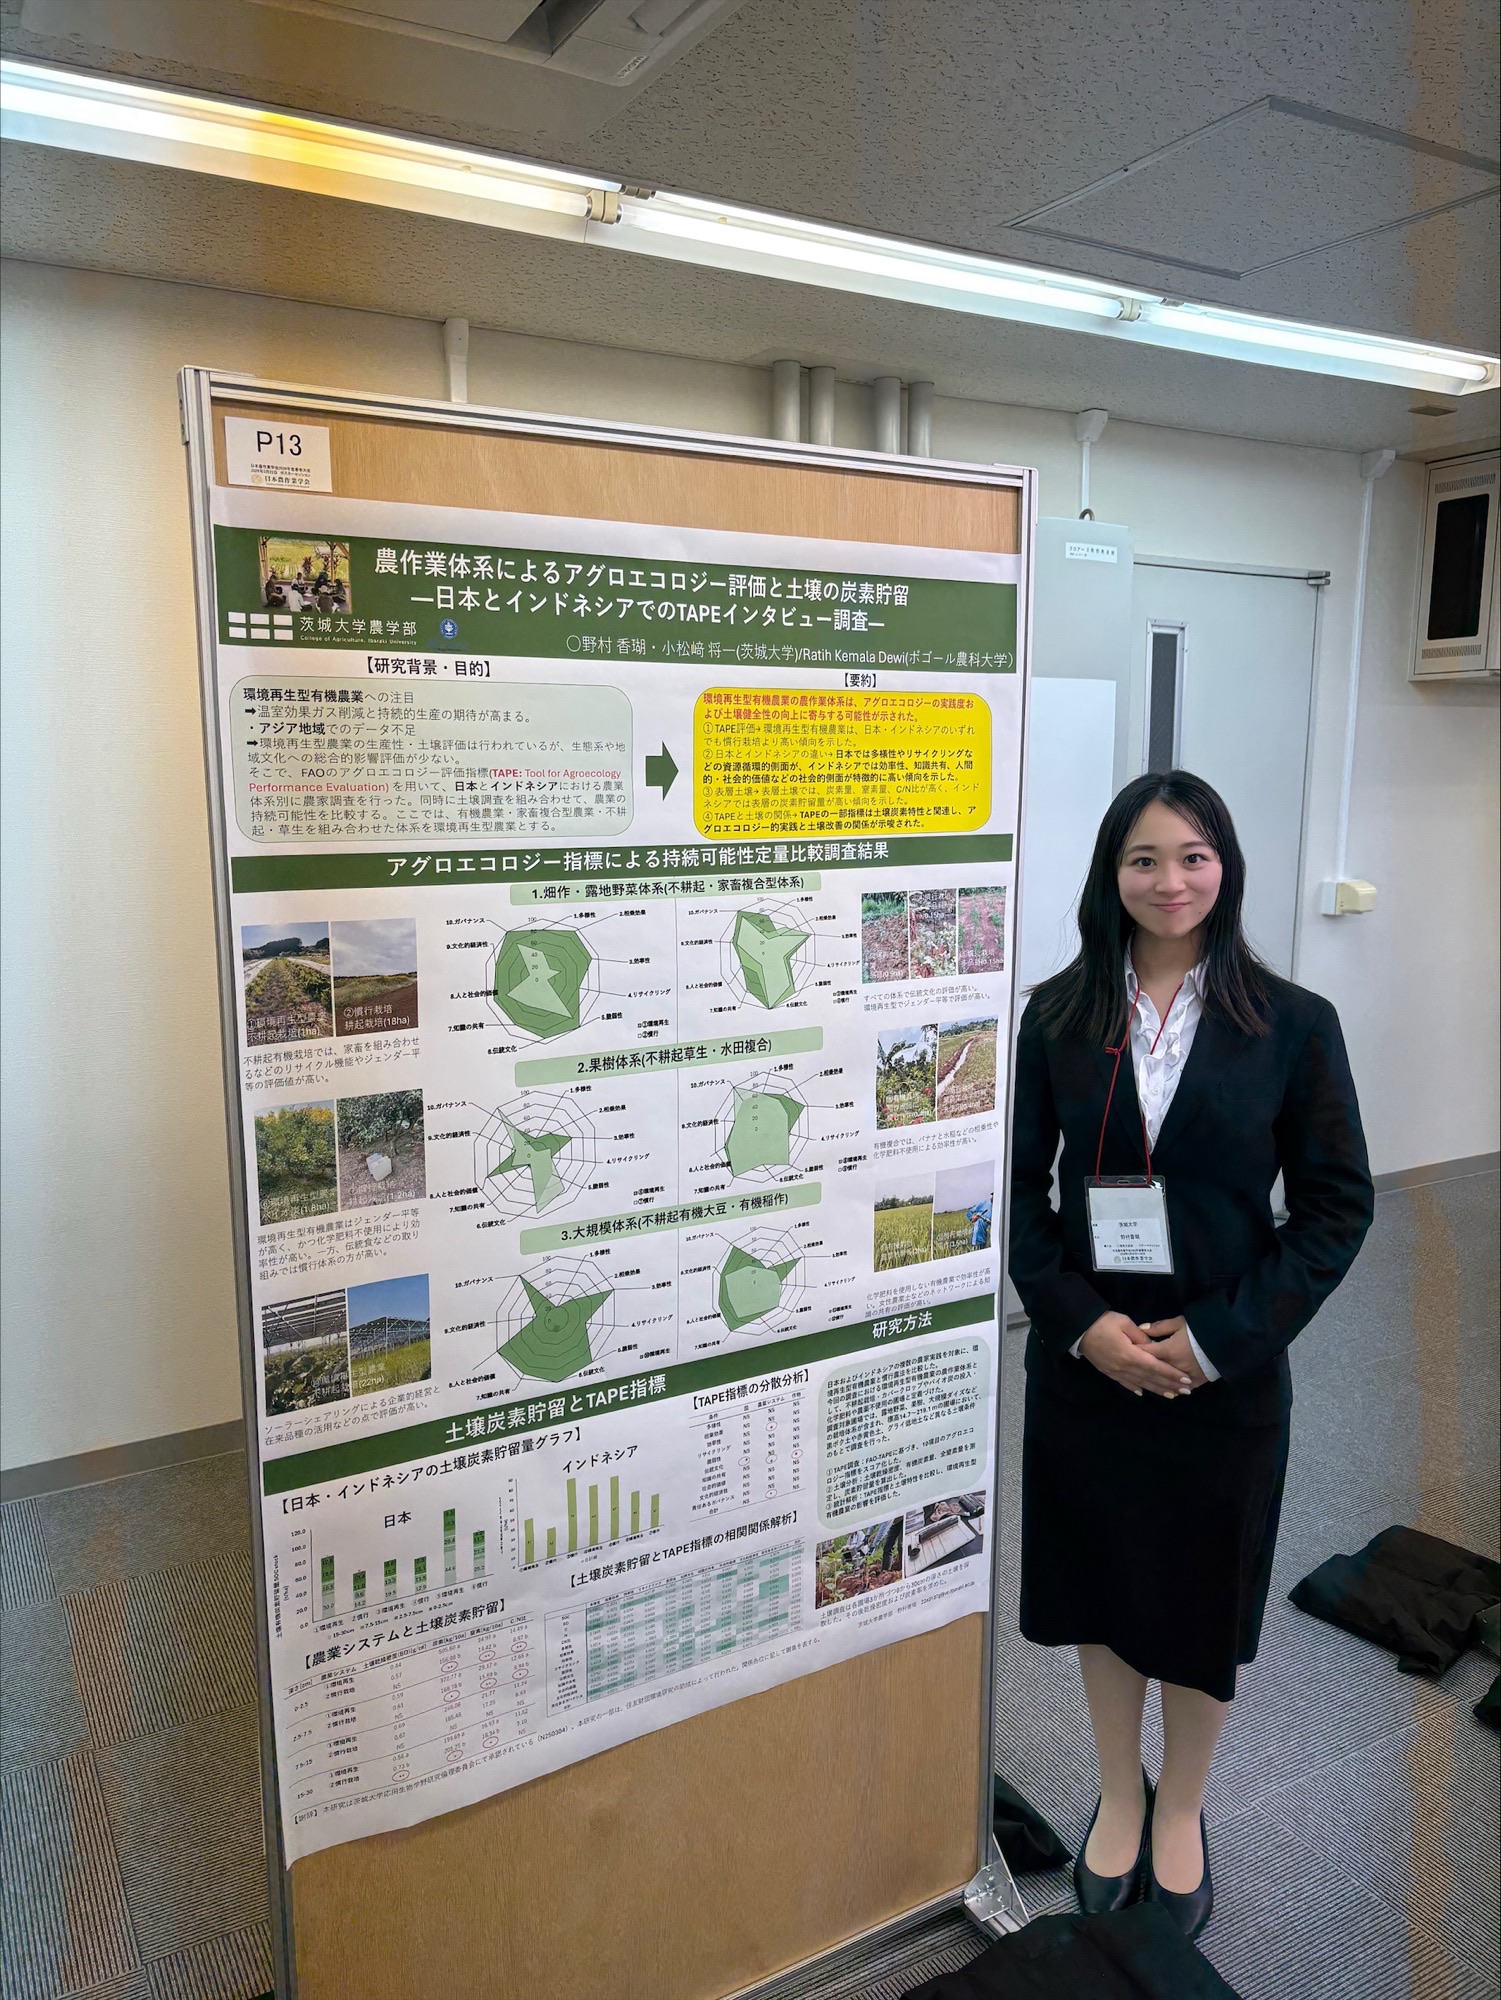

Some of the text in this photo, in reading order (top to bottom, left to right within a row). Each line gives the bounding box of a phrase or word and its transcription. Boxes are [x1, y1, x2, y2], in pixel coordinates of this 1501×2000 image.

[256, 431, 302, 456] P13
[374, 547, 909, 607] 農作業体系によるアグロエコロジー評価と土壌の炭素貯留
[300, 617, 417, 636] 茨城大学農学部
[367, 656, 491, 677] 【研究背景・目的】
[835, 650, 876, 663] Kemala
[844, 673, 877, 688] 【要約】
[243, 688, 414, 704] 環境再生型有機農業への注目
[249, 782, 323, 793] Performance
[326, 782, 389, 794] Evaluation)
[525, 769, 545, 778] Tool
[547, 769, 561, 778] for
[563, 769, 622, 780] Agroecology
[386, 841, 889, 877] アグロエコロジー指標による持続可能性定量比較調査結果
[577, 1038, 772, 1074] 2.果樹体系(不耕起草生・水田複合)
[245, 1073, 330, 1091] 等の評価値が高い。
[257, 1208, 420, 1245] 環境再生型有機農業はジェンダー平等
[561, 1192, 789, 1242] 3.大規模体系(不耕起有機大豆・有機稲作)
[872, 1311, 932, 1339] 研究方法
[693, 1368, 809, 1410] 【TAPE指標の分散分析】
[445, 1373, 667, 1444] 土壌炭素貯留とTAPE指標
[282, 1426, 581, 1515] 【日本・インドネシアの土壌炭素貯留量グラフ】
[562, 1445, 638, 1473] インドネシア
[384, 1510, 411, 1528] 日本
[304, 1598, 506, 1670] 【農業システムと土壌炭素貯留】
